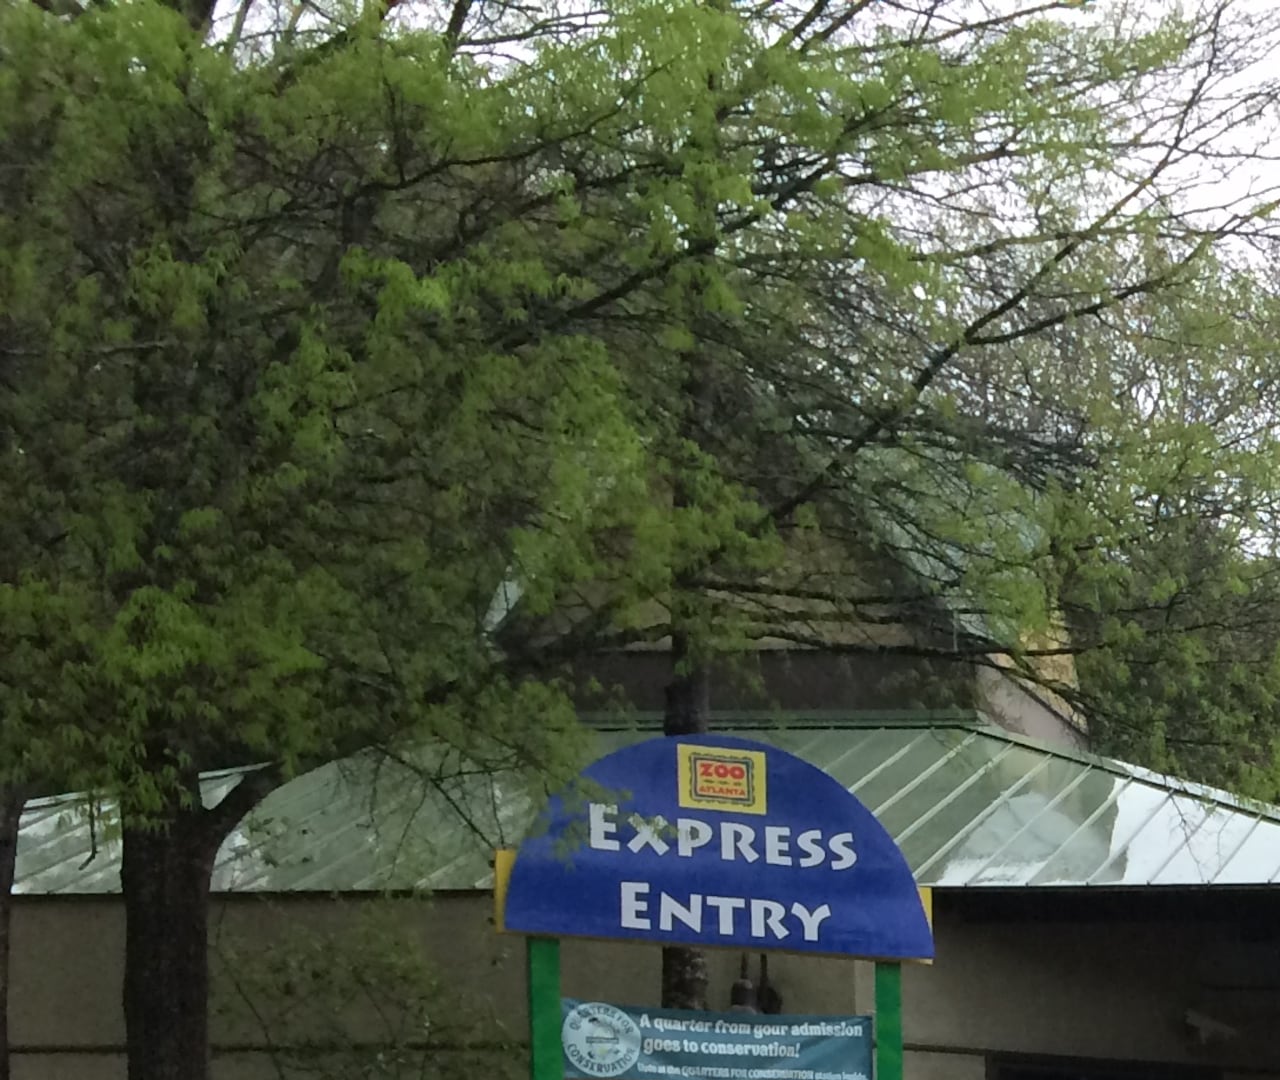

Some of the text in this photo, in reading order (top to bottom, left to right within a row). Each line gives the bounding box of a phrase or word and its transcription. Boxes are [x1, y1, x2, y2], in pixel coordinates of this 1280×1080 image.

[700, 763, 745, 780] ZOO
[699, 785, 746, 797] ATLANTA
[588, 802, 858, 871] EXPRESS
[620, 881, 832, 941] ENTRY
[639, 1013, 863, 1039] A quarter from your admission
[567, 1043, 636, 1073] CONSERVATION
[643, 1037, 801, 1058] goes to conservation!
